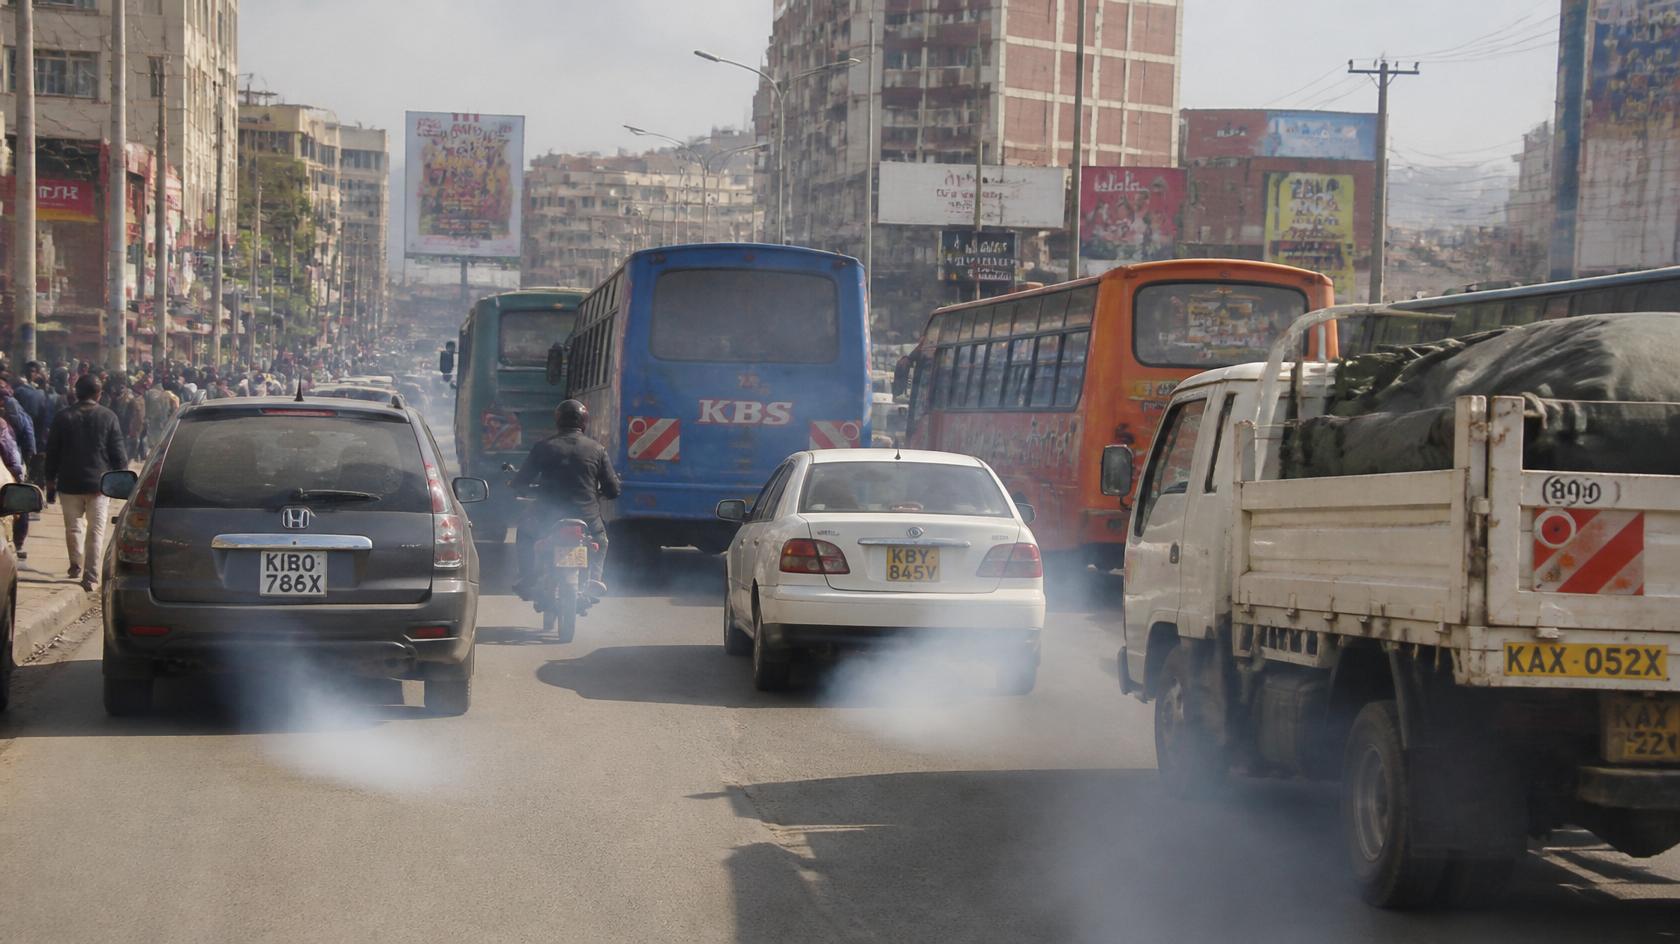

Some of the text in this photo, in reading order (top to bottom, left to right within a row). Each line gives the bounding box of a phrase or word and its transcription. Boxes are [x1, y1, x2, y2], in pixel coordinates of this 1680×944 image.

[698, 399, 793, 425] KBS
[890, 565, 937, 579] 845V
[265, 574, 321, 593] 786X
